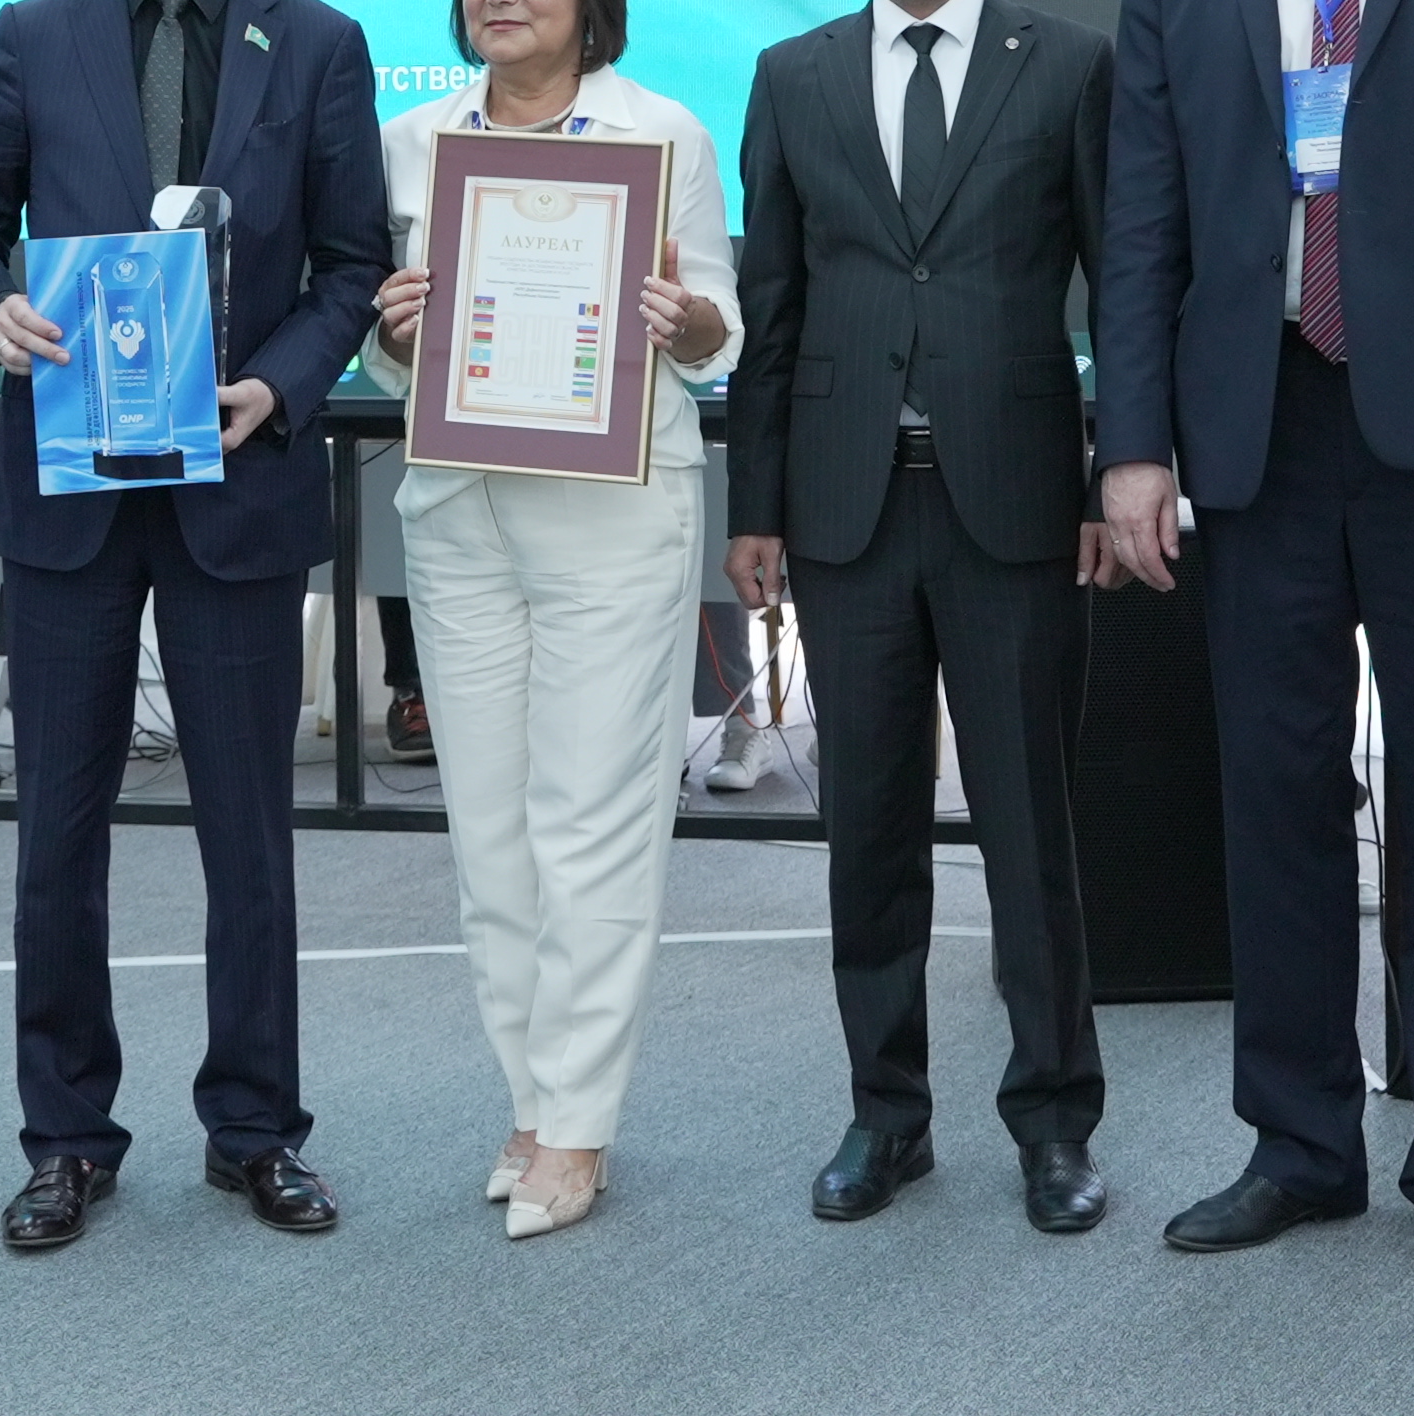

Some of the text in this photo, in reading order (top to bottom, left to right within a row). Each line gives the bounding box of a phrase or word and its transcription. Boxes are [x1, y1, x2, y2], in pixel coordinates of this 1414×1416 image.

[374, 65, 487, 92] тствен
[500, 234, 583, 252] ЛАУРЕАТ
[117, 305, 134, 313] 2025
[118, 413, 144, 424] QNP
